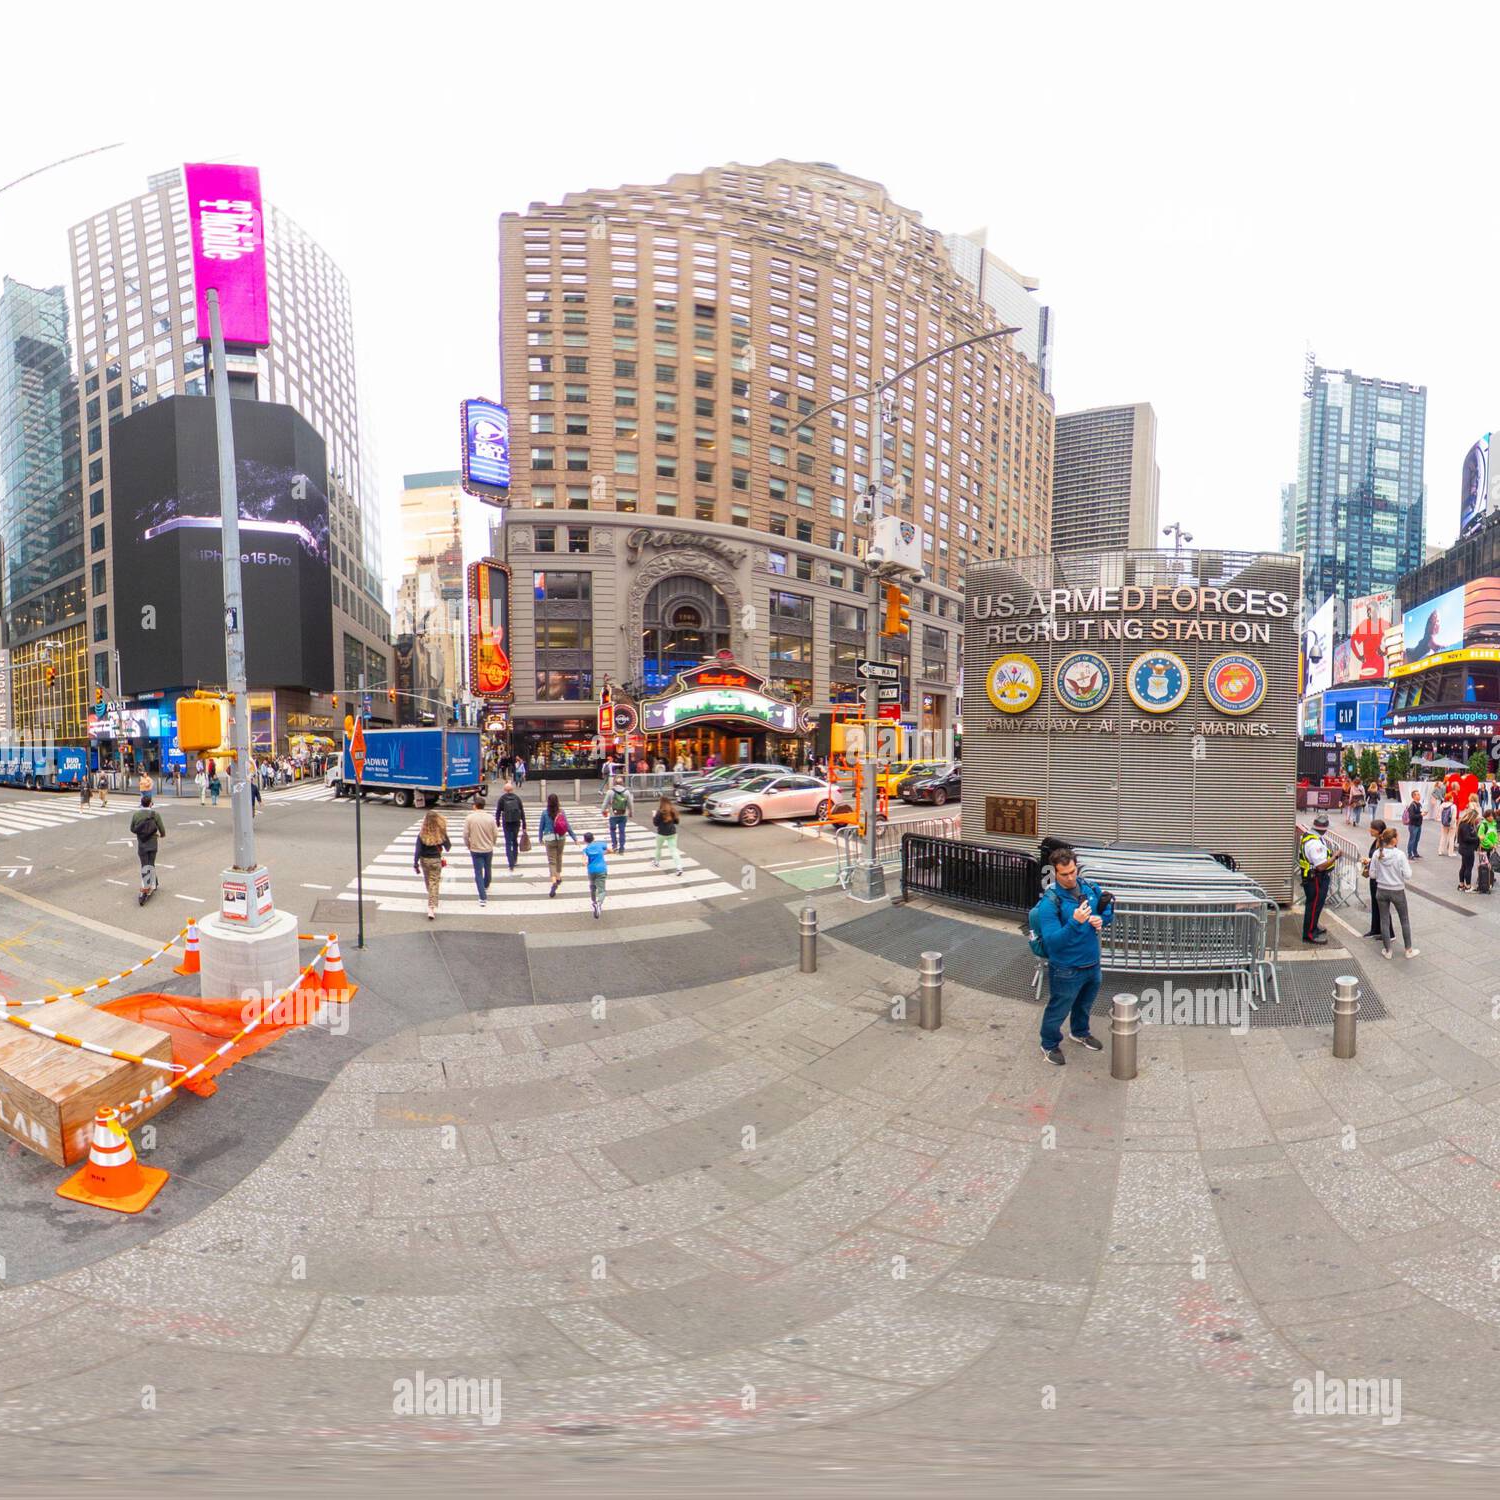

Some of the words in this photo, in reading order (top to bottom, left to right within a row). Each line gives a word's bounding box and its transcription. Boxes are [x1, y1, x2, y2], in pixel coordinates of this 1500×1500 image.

[200, 549, 250, 563] iPhe
[251, 552, 267, 565] 15
[269, 553, 292, 566] Pro
[973, 596, 1022, 620] U.S.
[1026, 585, 1146, 616] ARMED
[1151, 585, 1289, 617] FORCES
[1150, 618, 1271, 644] STATION
[863, 665, 876, 675] ONE
[881, 668, 895, 677] WAY
[881, 689, 895, 698] WAY
[1339, 709, 1353, 723] GAP
[1418, 713, 1449, 722] Department
[1450, 712, 1488, 722] struggles
[1489, 712, 1498, 720] to
[985, 719, 1024, 732] ARMY
[1034, 719, 1080, 732] NAVY
[1200, 720, 1270, 736] MARINES
[1449, 725, 1464, 735] join
[1465, 725, 1480, 735] Big
[1482, 725, 1494, 734] 12
[75, 1076, 166, 1150] HLAN
